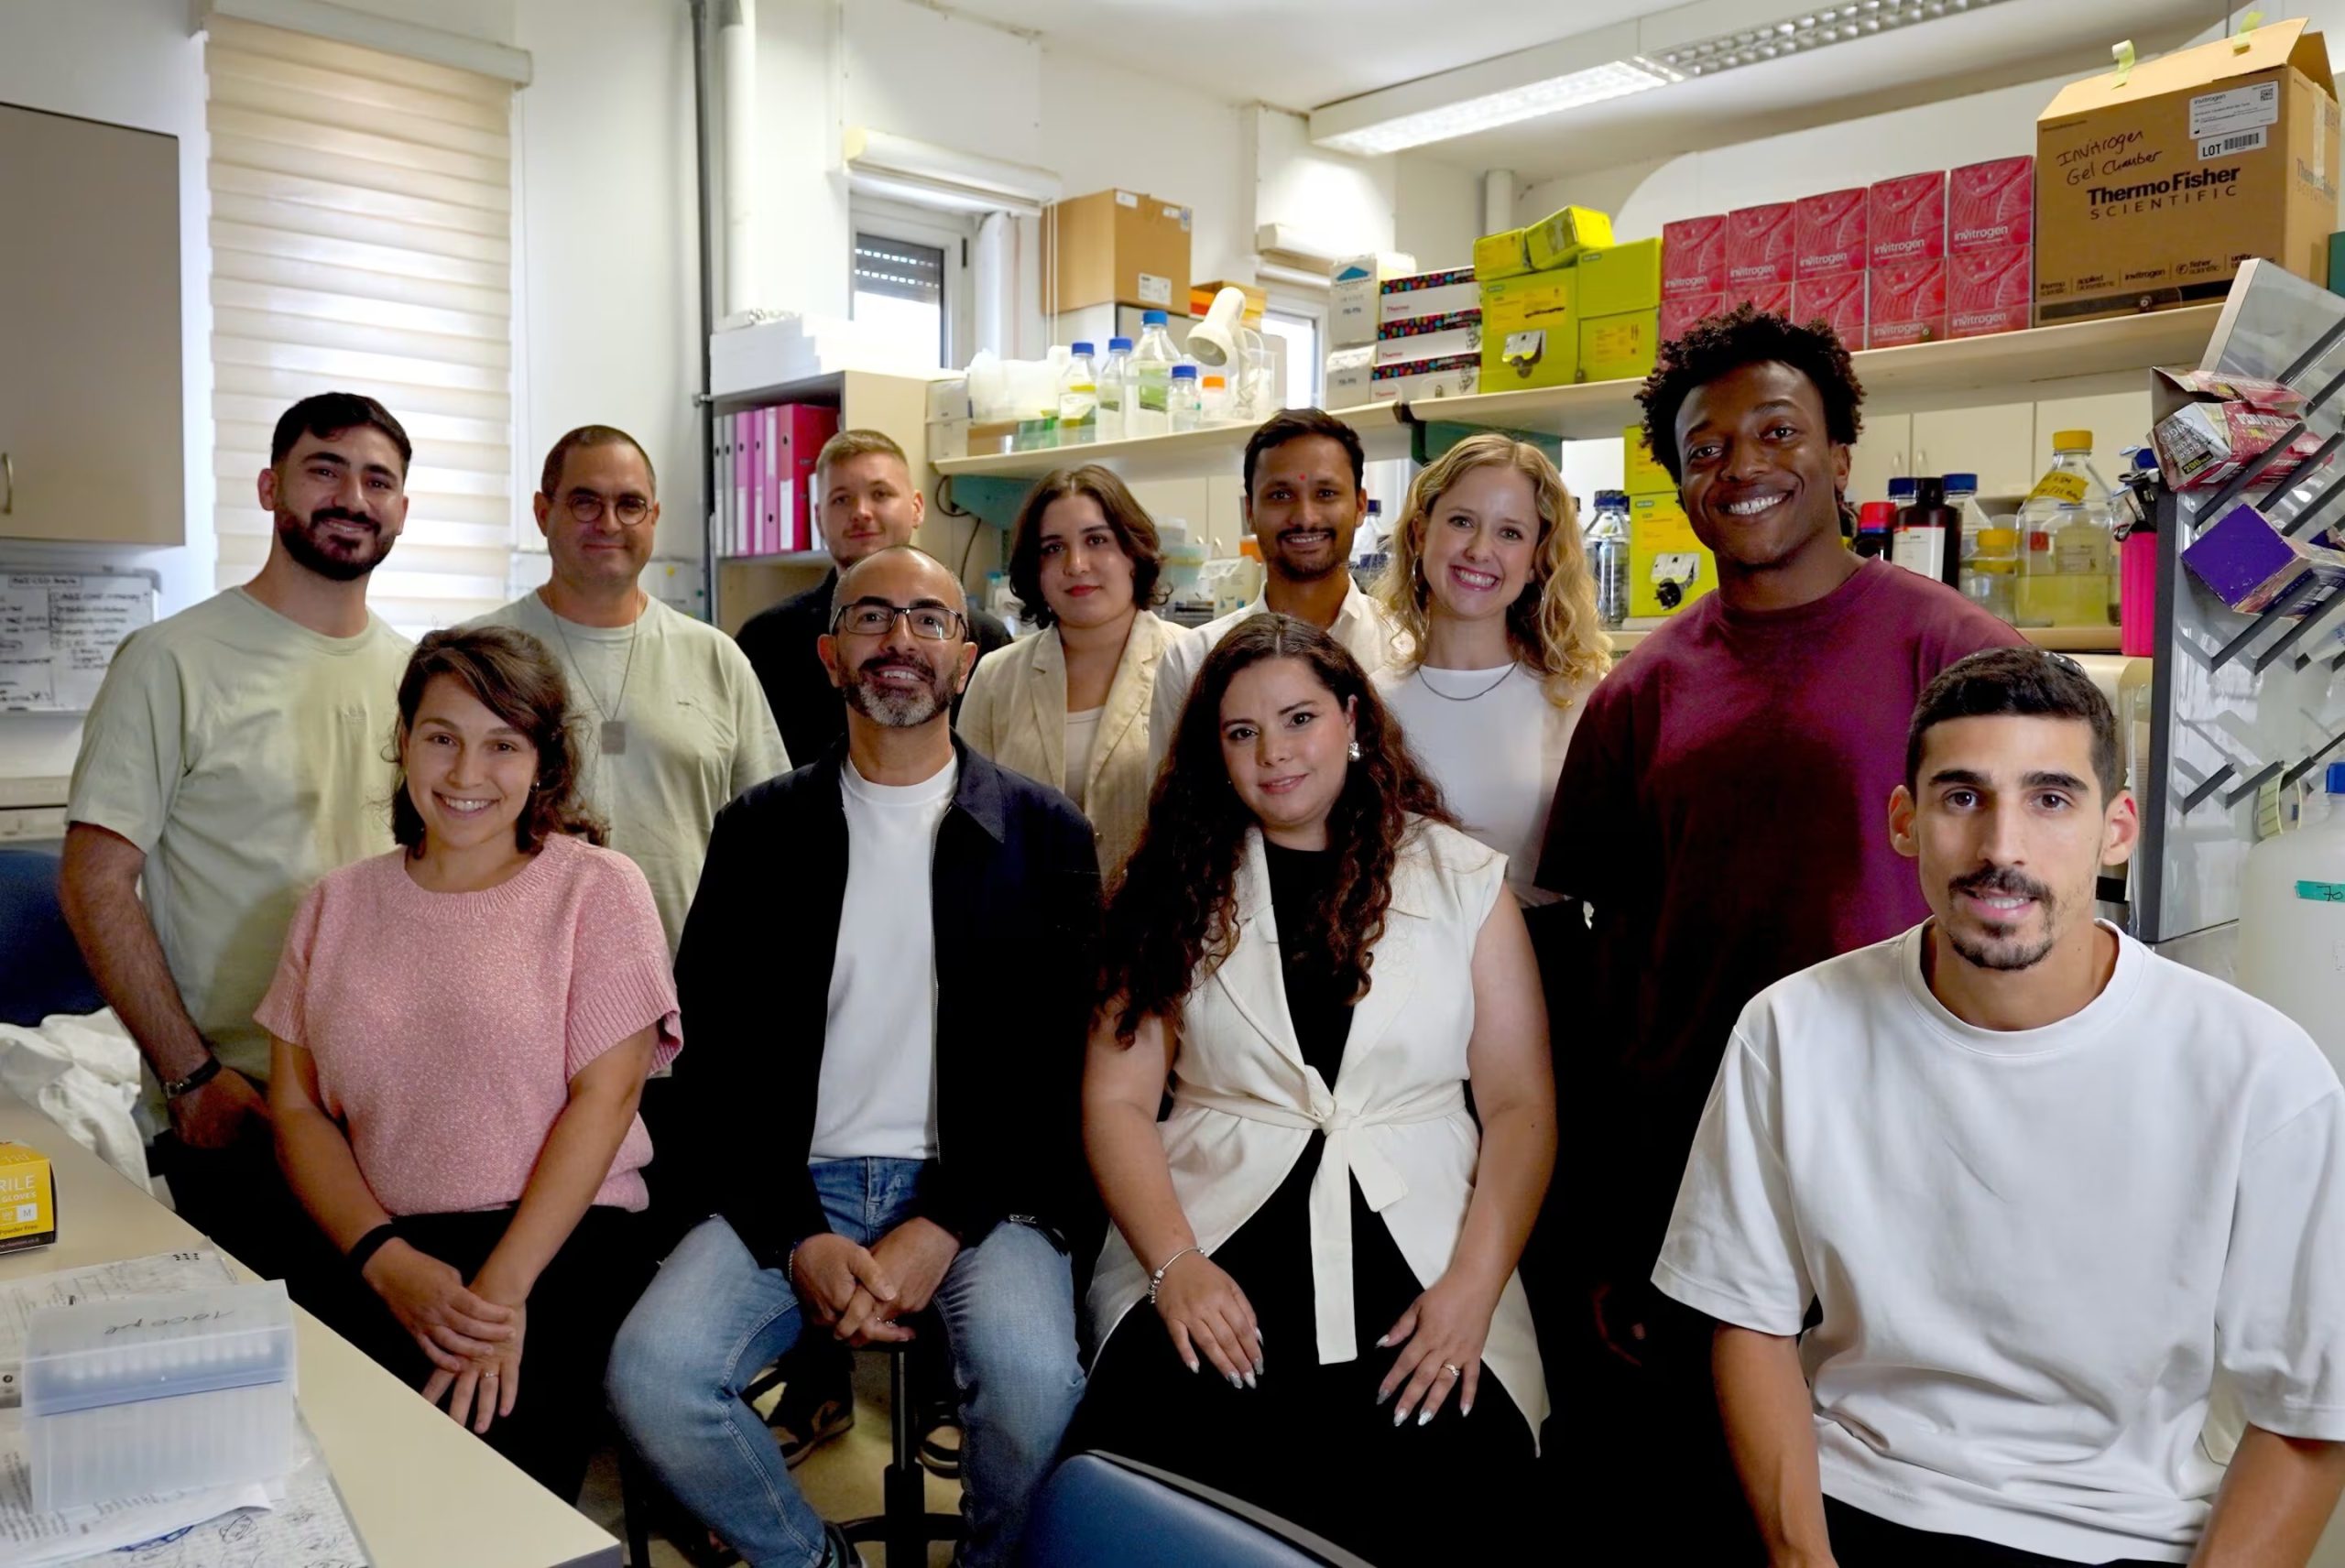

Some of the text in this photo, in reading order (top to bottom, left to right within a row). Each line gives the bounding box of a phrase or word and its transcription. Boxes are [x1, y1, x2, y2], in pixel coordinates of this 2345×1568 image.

[2202, 143, 2222, 158] LOT
[2066, 162, 2096, 186] Gel
[2089, 184, 2237, 220] SCIENTIFIC
[1954, 224, 2009, 242] invitrogen
[1874, 238, 1925, 255] invitrogen
[1800, 251, 1848, 267] invitrogen
[1730, 263, 1775, 278] invitrogen
[2125, 267, 2165, 281] invitrogen
[1665, 275, 1707, 289] invitrogen
[1953, 311, 2007, 328] invitrogen
[1874, 321, 1924, 337] invitrogen
[23, 1209, 32, 1218] M
